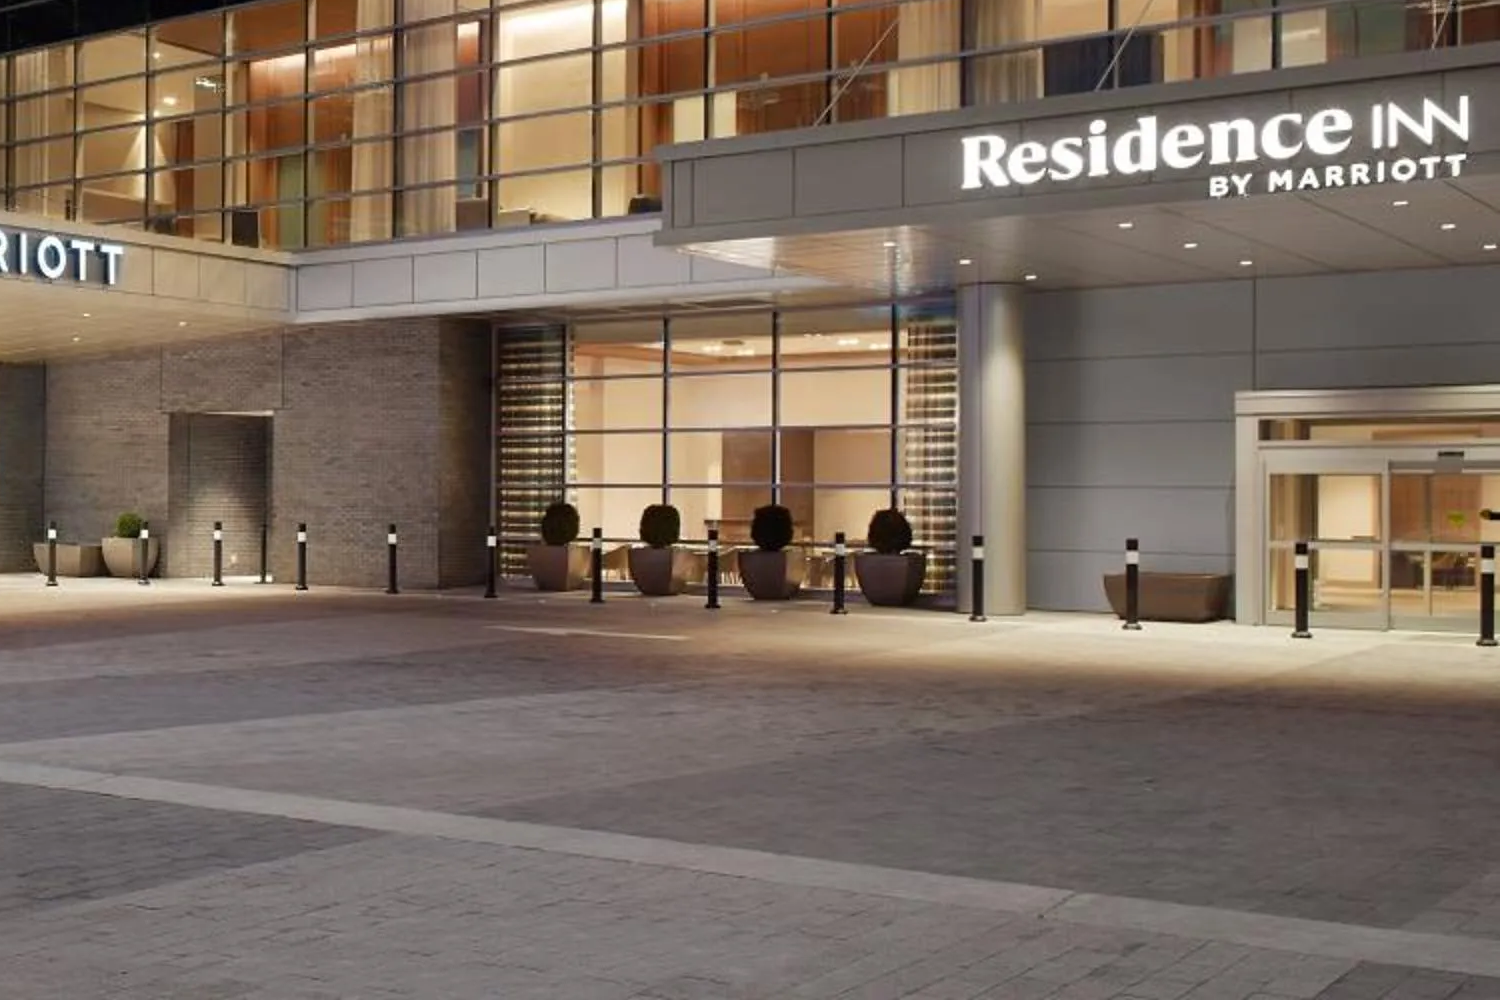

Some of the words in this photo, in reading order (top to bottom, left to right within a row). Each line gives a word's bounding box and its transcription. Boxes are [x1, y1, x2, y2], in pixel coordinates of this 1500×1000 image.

[960, 104, 1354, 190] Residence
[1370, 94, 1470, 150] INN
[1208, 172, 1253, 198] BY
[1266, 152, 1468, 193] MARRIOTT
